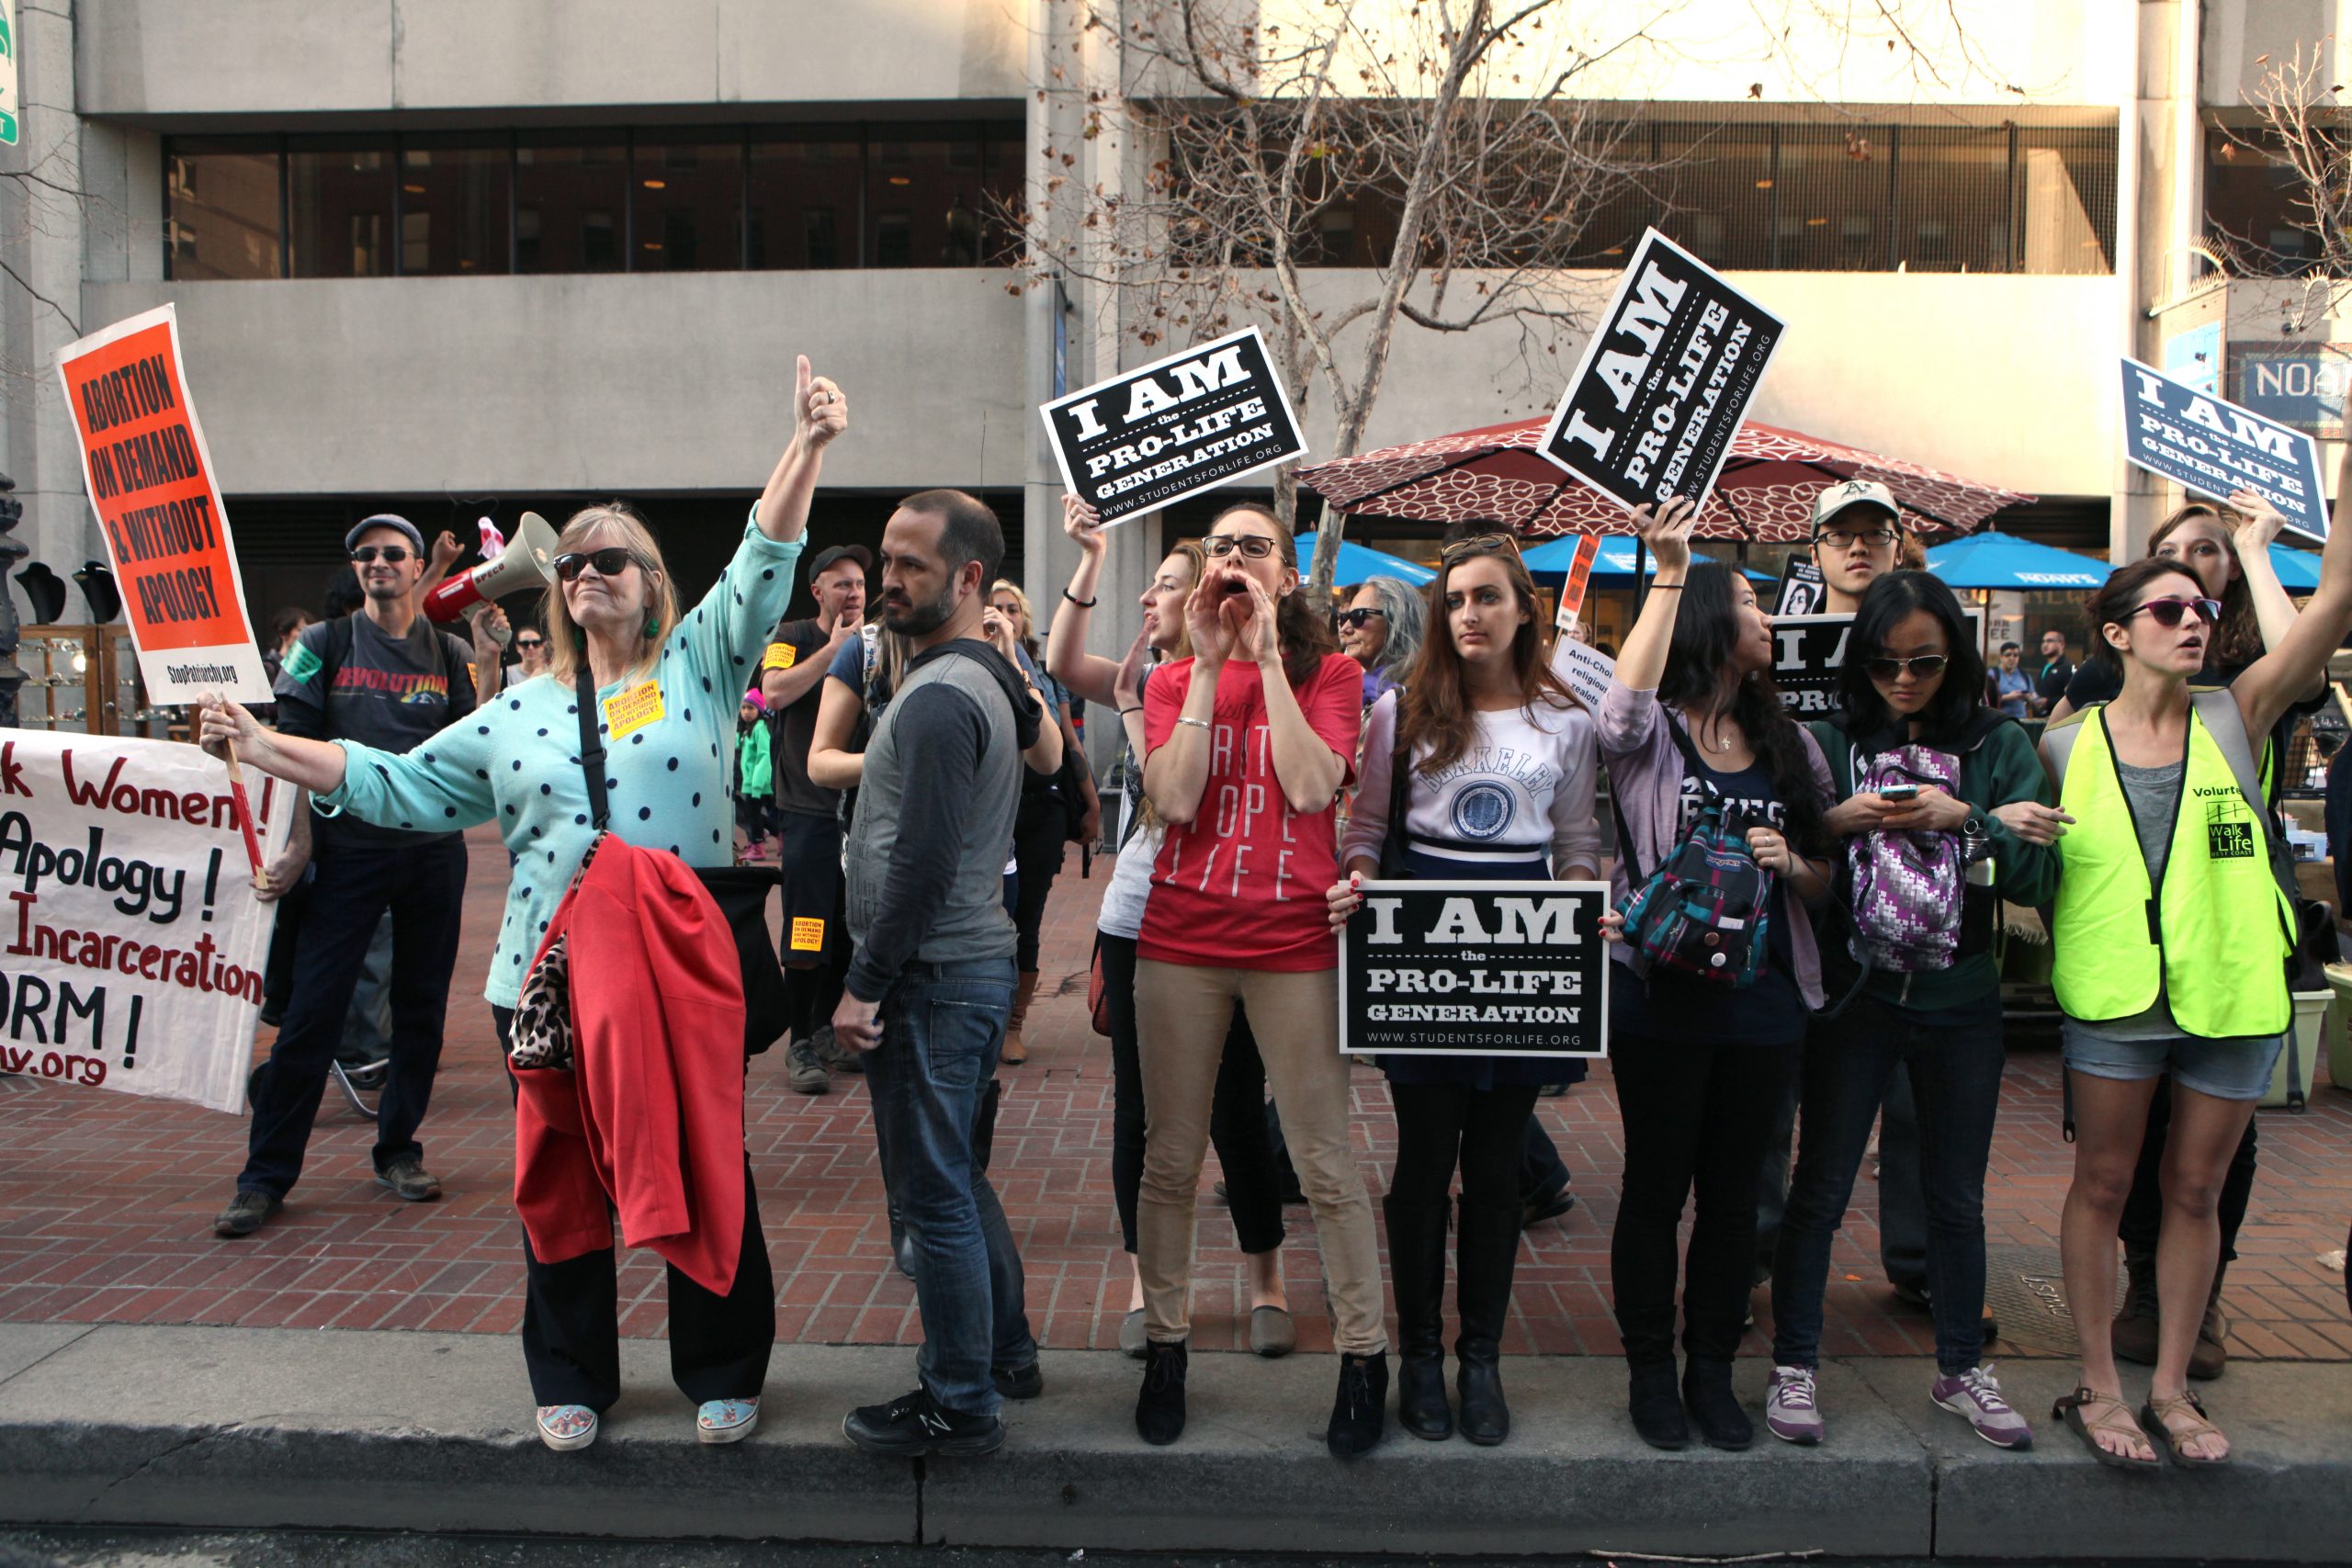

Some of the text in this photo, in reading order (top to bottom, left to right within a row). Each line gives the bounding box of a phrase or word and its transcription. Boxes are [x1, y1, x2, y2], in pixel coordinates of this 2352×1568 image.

[1563, 260, 1688, 462] I AM
[1647, 368, 1664, 391] the
[2256, 362, 2350, 396] NOA
[82, 354, 175, 434] ABORTION
[1069, 345, 1252, 442] I AM
[1623, 299, 1730, 490] PRO-LIFE
[1656, 319, 1752, 504] GENERATION
[1086, 396, 1267, 479] PRO-LIFE
[1158, 412, 1180, 425] the
[1682, 334, 1771, 506] WW.STUDENTSFORLIFE.ORG
[2135, 370, 2299, 465] I AM
[2209, 433, 2229, 446] the
[90, 423, 198, 500] ON DEMAND
[1096, 423, 1274, 500] GENERATION
[2140, 413, 2304, 497] PRO-LIFE
[2142, 436, 2307, 514] GENERATION
[1102, 444, 1283, 517] WWW.STUDENTSFORLIFE.ORG
[109, 496, 216, 565] & WITHOUT
[136, 567, 220, 625] APOLOGY
[475, 563, 504, 584] SPECO
[1568, 649, 1612, 679] Anti-Choi
[1776, 629, 1806, 671] I
[167, 664, 239, 685] StopPatriarchy.org
[609, 684, 654, 710] ABORTION
[1571, 682, 1599, 705] zealots
[1572, 667, 1608, 694] religious
[610, 692, 656, 717] ON DEMAND
[627, 699, 657, 716] WITHOUT
[1418, 747, 1555, 801] BERKELEY
[1191, 784, 1296, 842] OPE
[2210, 824, 2243, 837] Walk
[2218, 835, 2252, 852] Life
[1165, 838, 1293, 902] LIFE
[1367, 897, 1582, 944] I AM
[6, 891, 264, 1005] Incarceration
[1461, 950, 1487, 962] the
[1367, 969, 1582, 995] PRO-LIFE
[1367, 1004, 1581, 1023] GENERATION
[1367, 1032, 1581, 1045] WWW.STUDENTSFORLIFE.ORG
